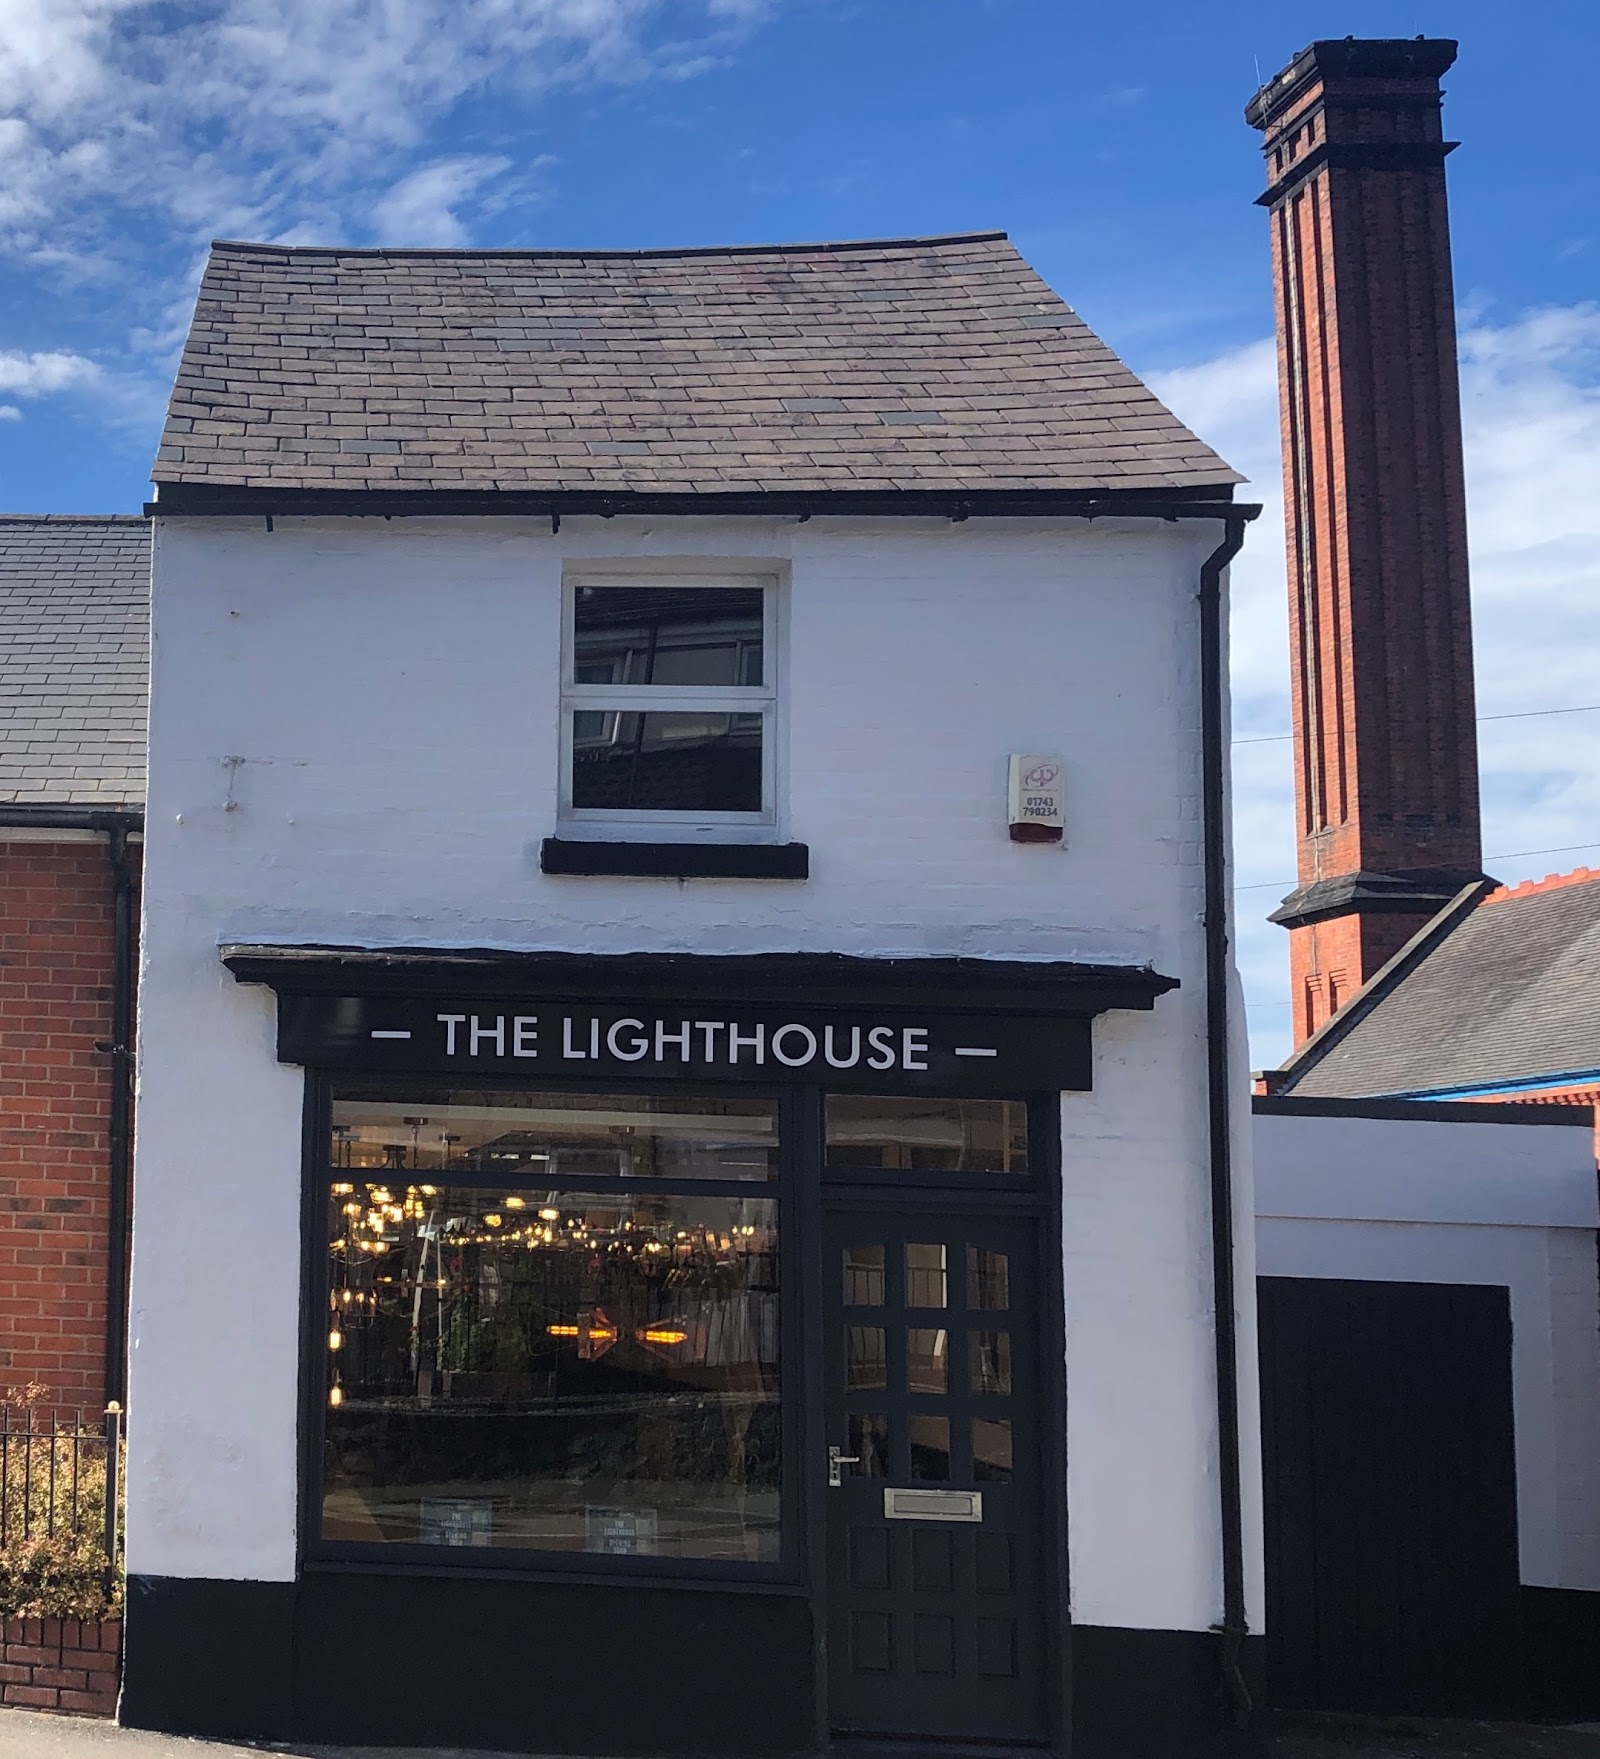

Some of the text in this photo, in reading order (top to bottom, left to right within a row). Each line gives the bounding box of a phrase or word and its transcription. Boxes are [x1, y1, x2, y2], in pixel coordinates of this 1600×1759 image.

[1026, 797, 1054, 807] 01743
[1022, 807, 1058, 817] 790234
[437, 1014, 928, 1071] THE LIGHTHOUSE
